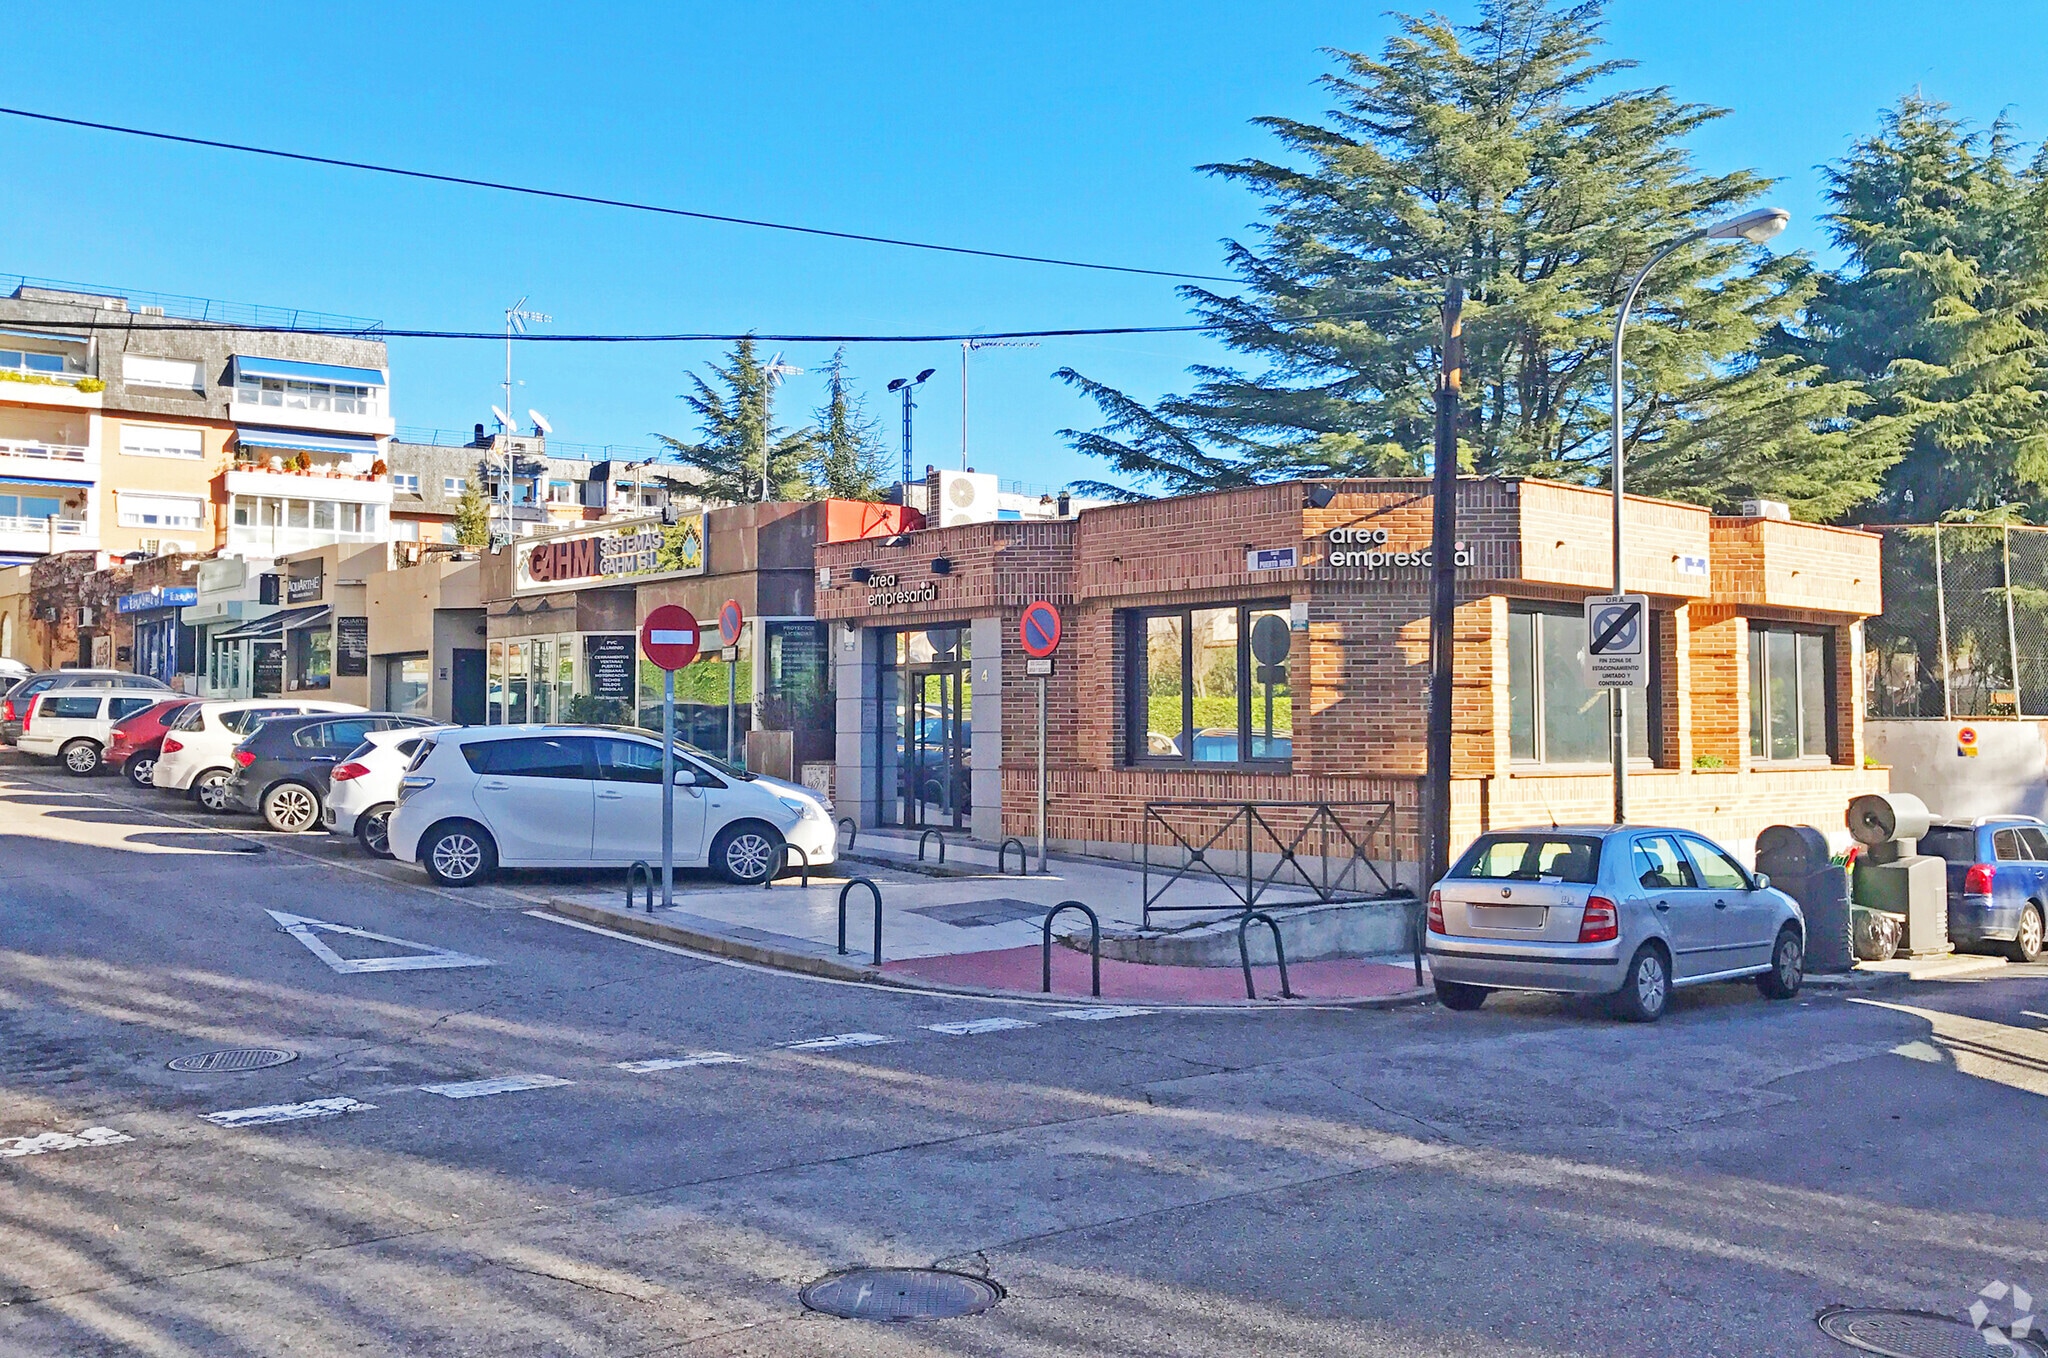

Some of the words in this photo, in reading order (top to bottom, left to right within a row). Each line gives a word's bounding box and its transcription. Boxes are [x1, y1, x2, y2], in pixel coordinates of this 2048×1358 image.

[600, 531, 664, 556] SISTEMAS
[529, 537, 595, 582] GAHM
[600, 554, 637, 575] GAHM
[1329, 546, 1475, 571] empresaal
[287, 576, 320, 592] AQUARTHE
[868, 574, 895, 588] área
[868, 581, 935, 609] empresarial
[981, 669, 989, 682] 4
